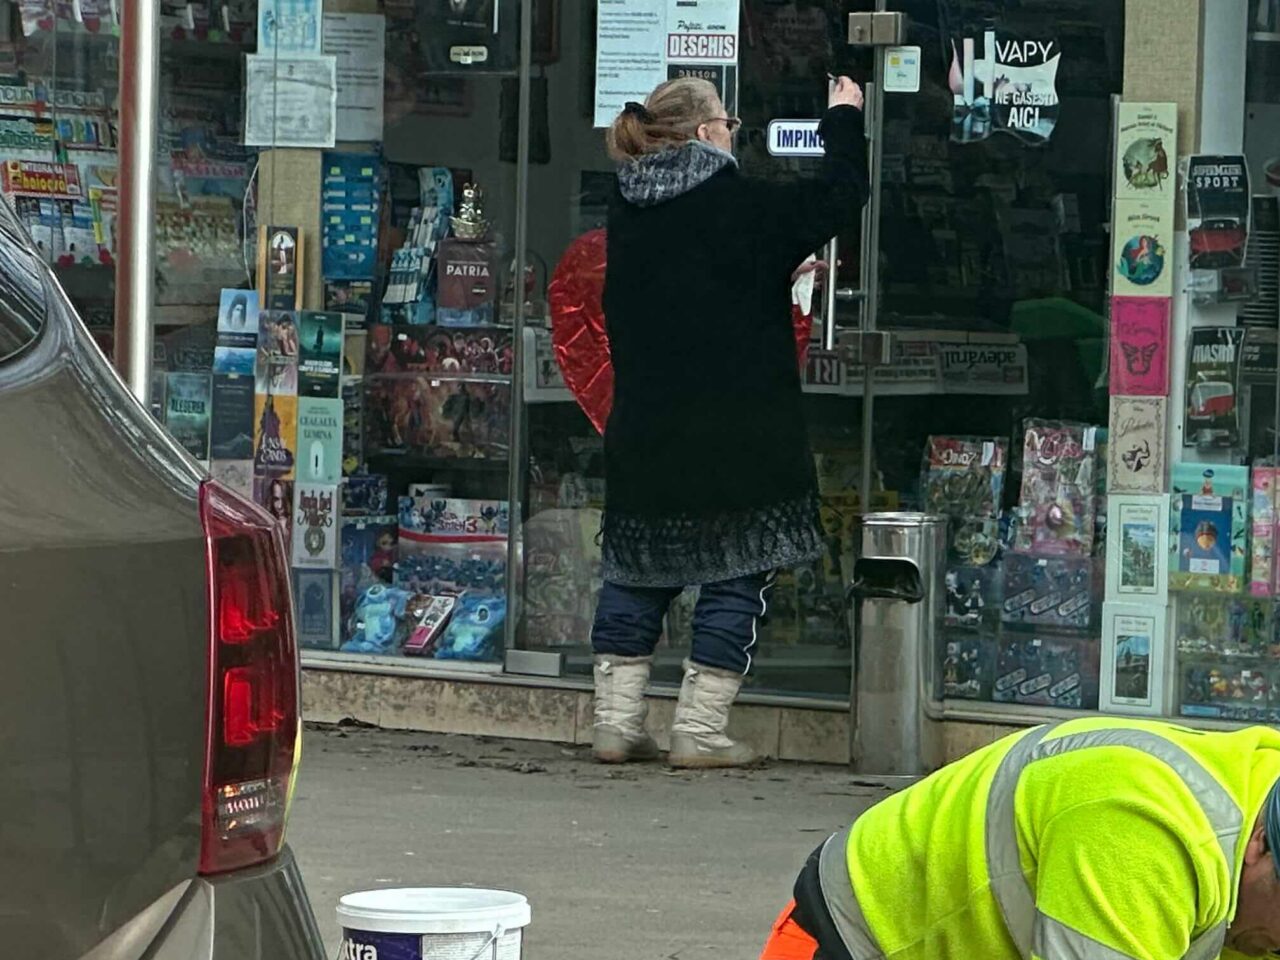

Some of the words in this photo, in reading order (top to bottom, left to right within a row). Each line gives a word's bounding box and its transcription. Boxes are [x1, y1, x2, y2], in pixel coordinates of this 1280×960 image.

[669, 35, 734, 57] DESCHIS
[995, 40, 1053, 63] VAPY
[1007, 106, 1039, 128] AICI
[1196, 176, 1239, 188] SPORT
[446, 263, 490, 277] PATRIA
